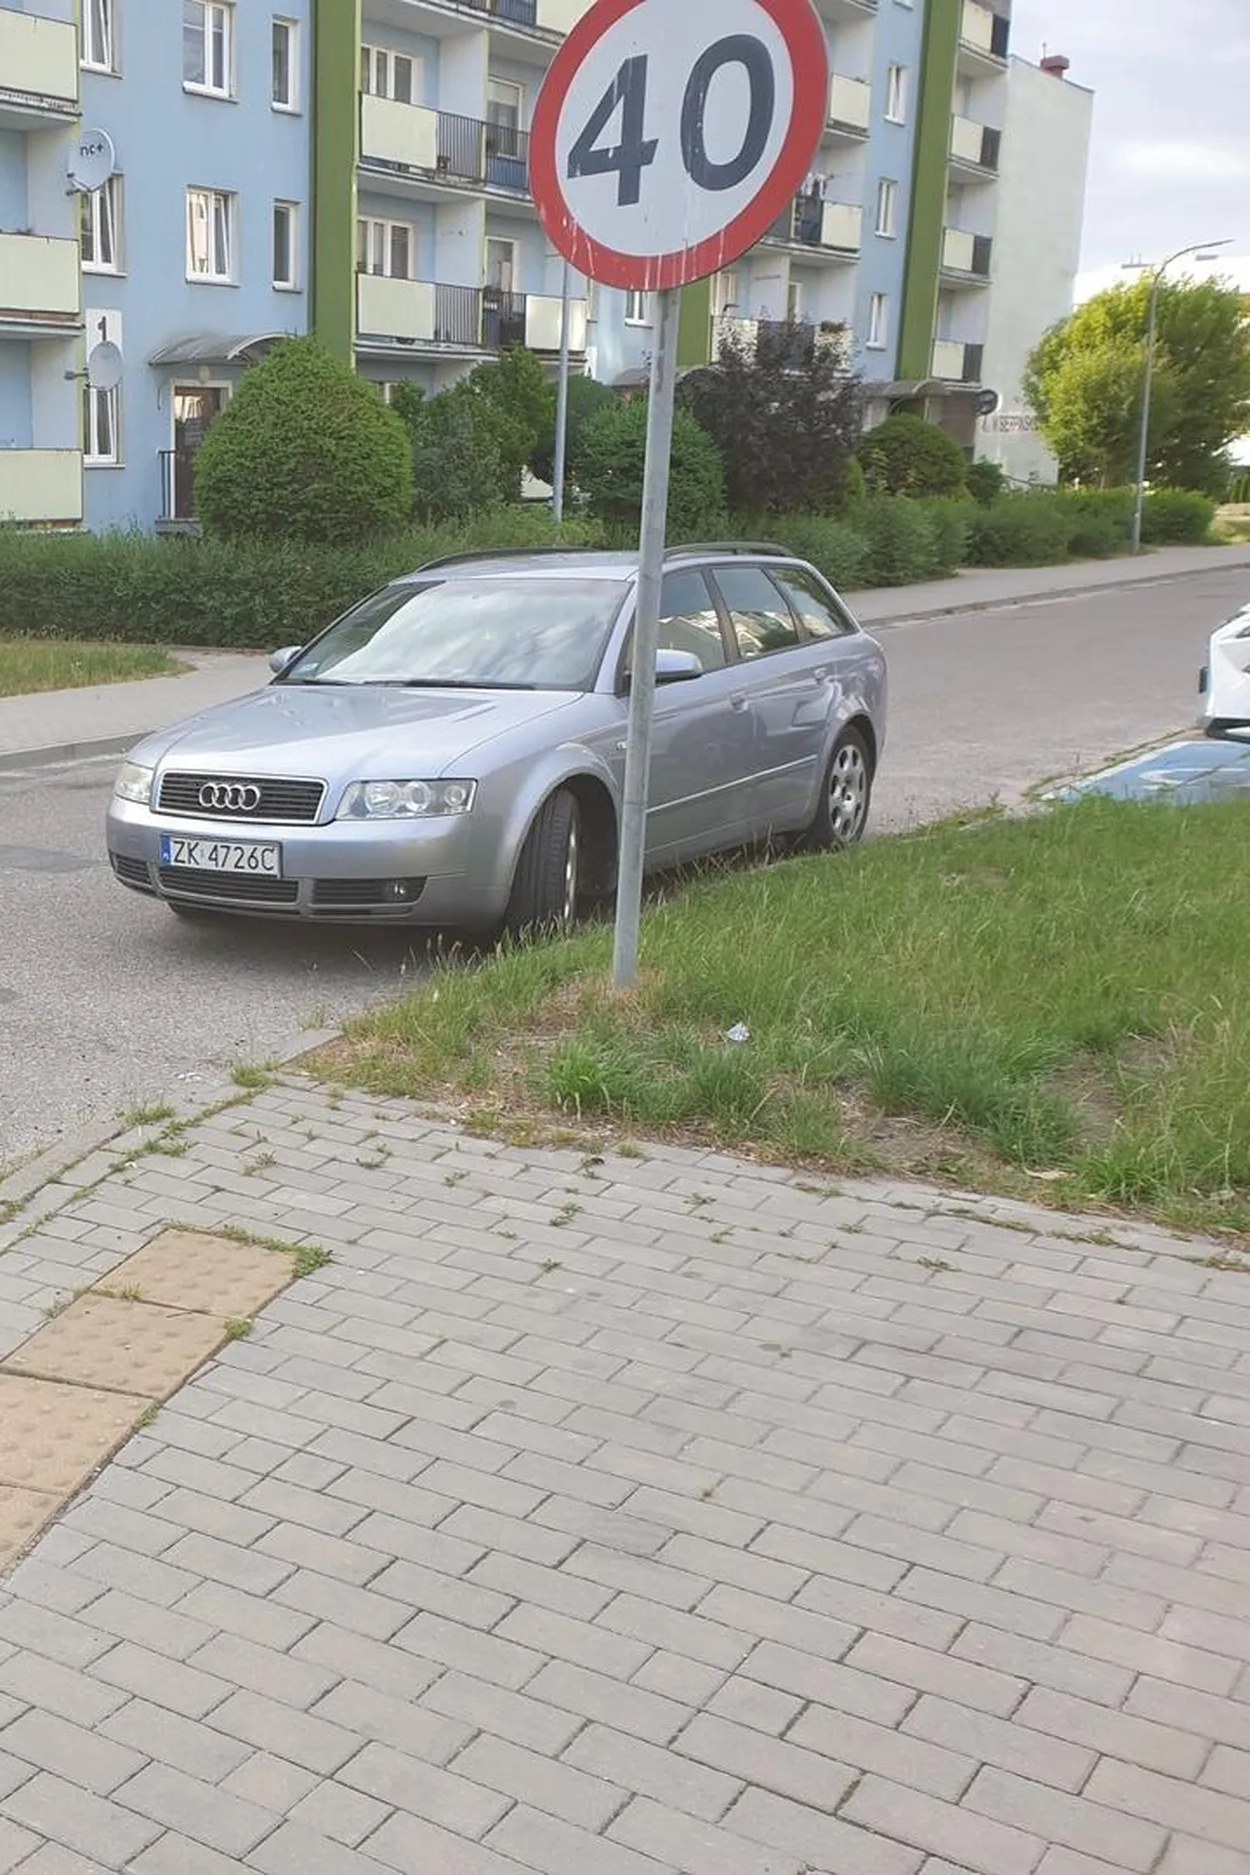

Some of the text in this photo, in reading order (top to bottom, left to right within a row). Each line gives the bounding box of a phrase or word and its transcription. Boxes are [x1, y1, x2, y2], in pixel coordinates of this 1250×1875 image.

[567, 33, 775, 207] 40
[97, 316, 107, 342] 1
[173, 840, 275, 871] ZK 4726C
